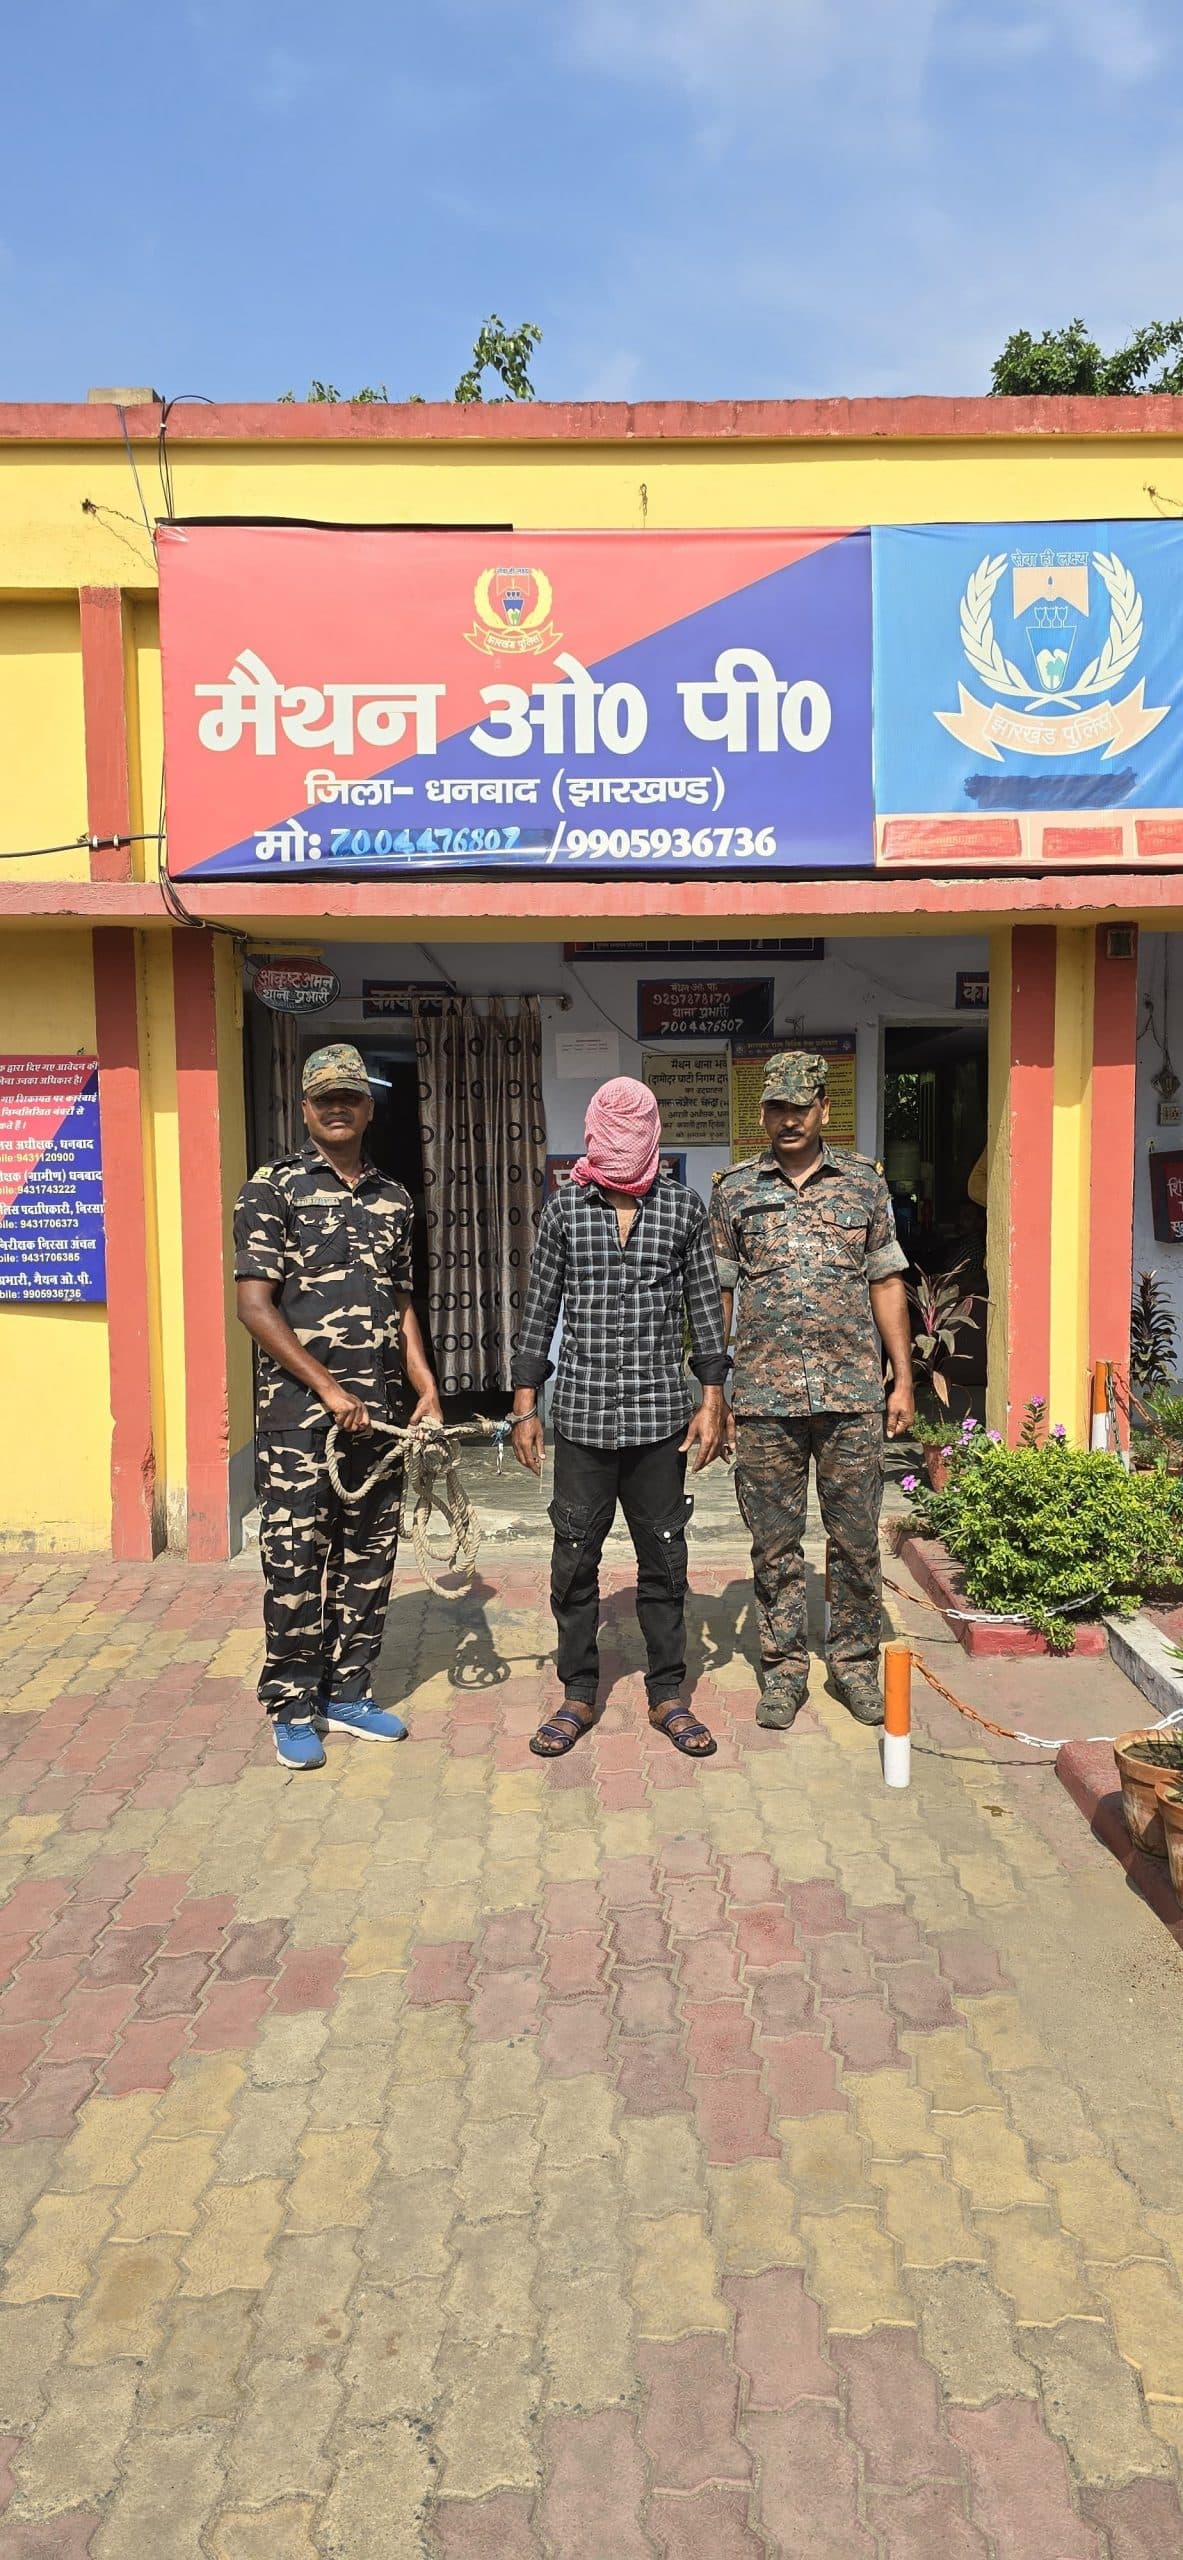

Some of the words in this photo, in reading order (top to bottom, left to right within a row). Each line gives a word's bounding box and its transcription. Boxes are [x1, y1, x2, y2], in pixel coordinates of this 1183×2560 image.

[1010, 549, 1038, 567] सेवा
[1040, 548, 1055, 567] ही
[194, 648, 446, 756] मैथन
[991, 715, 1057, 746] झारखंड
[1060, 711, 1115, 749] पुलिस
[425, 778, 541, 804] धनबाद
[551, 766, 726, 813] (झारखण्ड)
[60, 1139, 94, 1149] धनबाद
[18, 1184, 76, 1194] 9431743222
[20, 1219, 79, 1229] 9431706373
